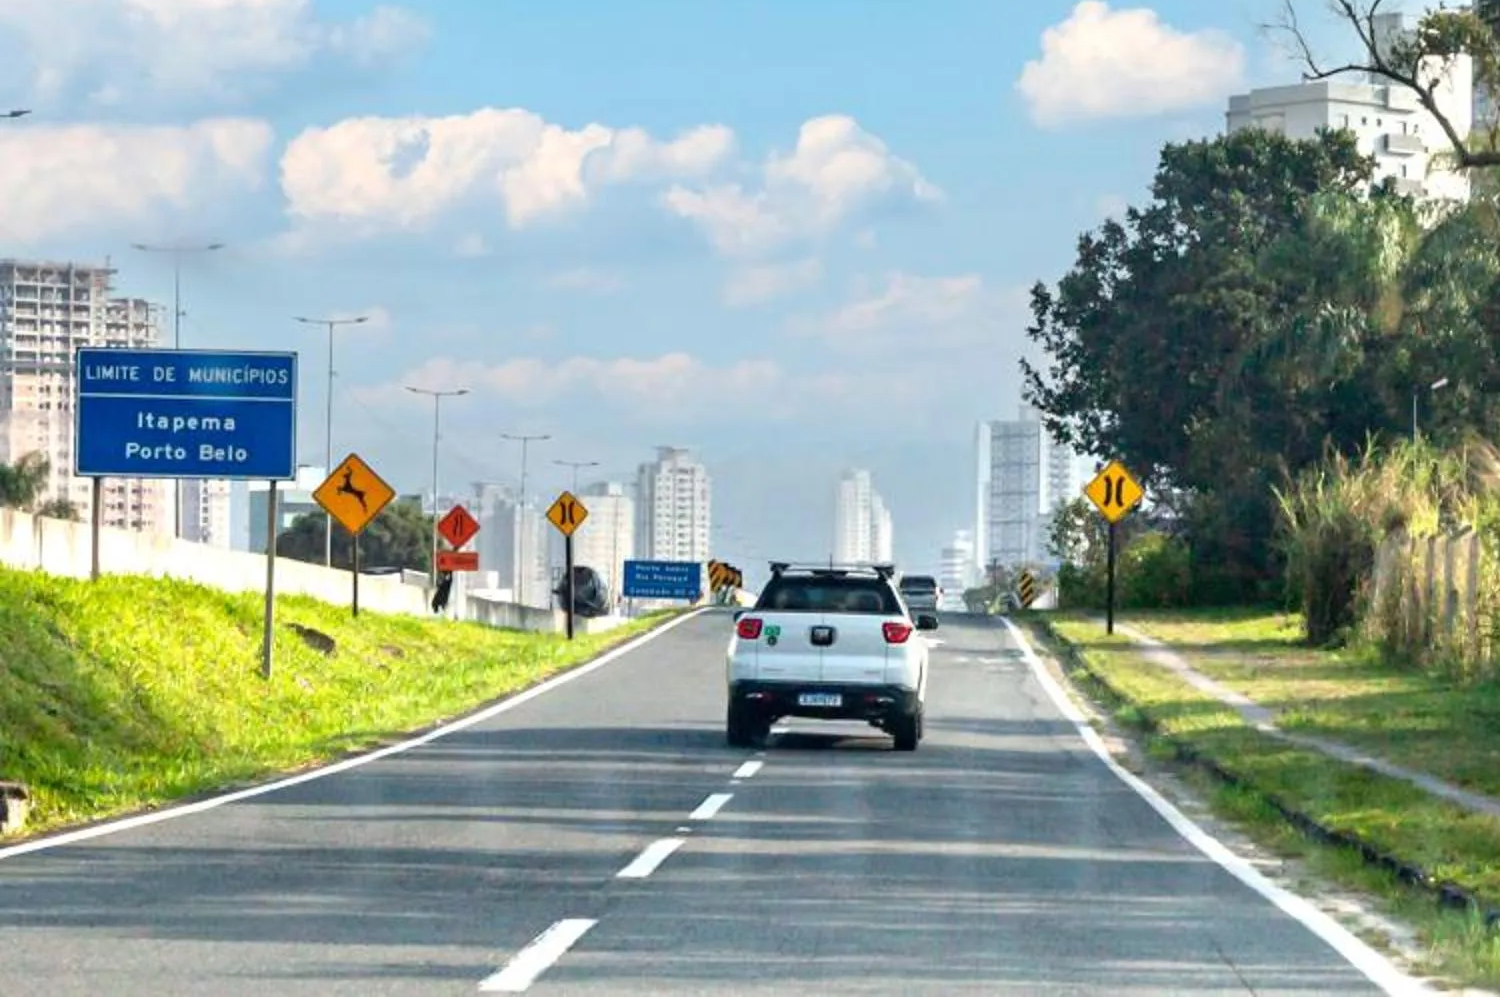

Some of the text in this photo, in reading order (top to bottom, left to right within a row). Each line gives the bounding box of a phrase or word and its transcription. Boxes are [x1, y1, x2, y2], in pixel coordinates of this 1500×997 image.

[85, 363, 289, 384] LIMITE DE MUNICÍPIOS
[137, 411, 236, 433] Itapema
[125, 442, 248, 462] Porto Belo
